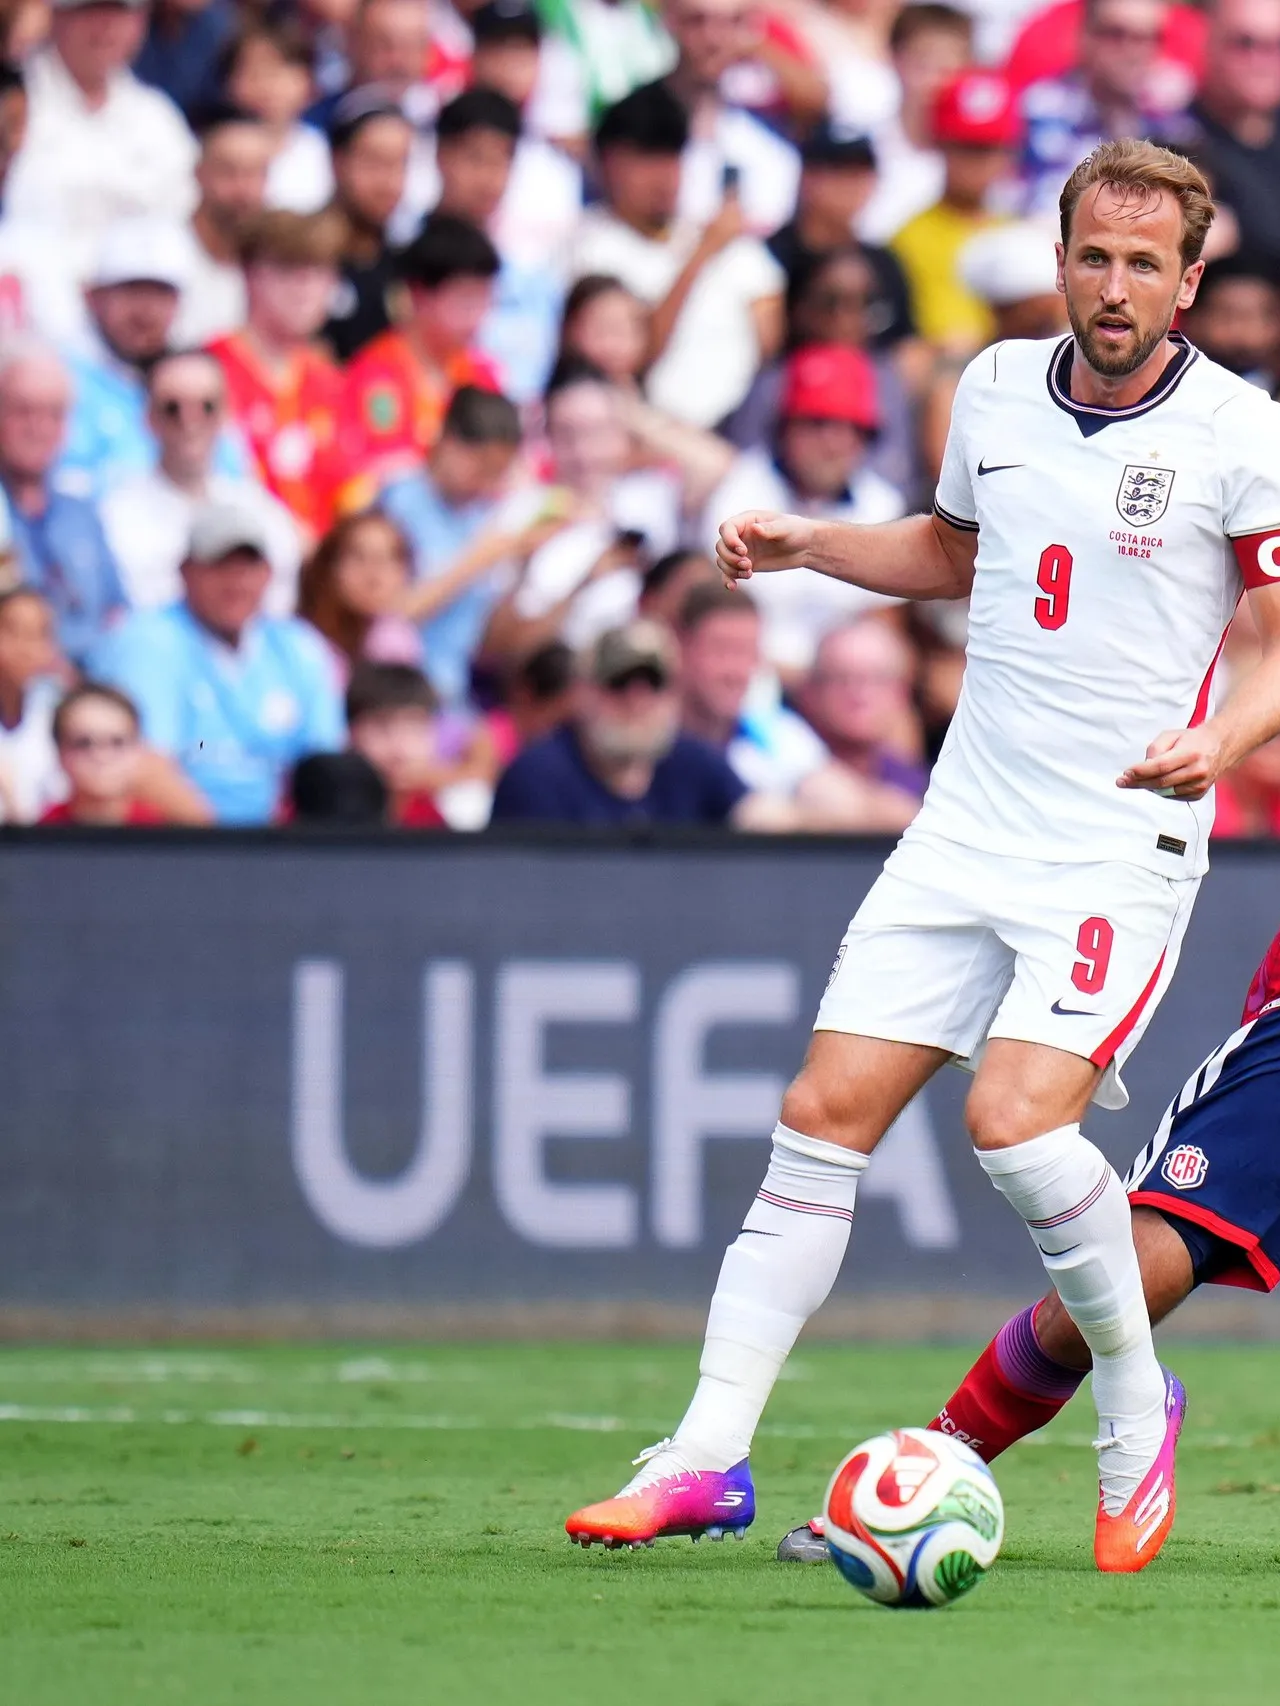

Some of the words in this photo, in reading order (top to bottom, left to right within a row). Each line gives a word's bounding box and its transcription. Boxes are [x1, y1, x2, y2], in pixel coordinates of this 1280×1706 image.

[1109, 530, 1138, 545] COSTA
[1140, 535, 1163, 548] RICA
[1117, 545, 1151, 559] 10.06.26
[1034, 543, 1073, 631] 9
[1071, 916, 1115, 996] 9
[1171, 1153, 1199, 1180] CR
